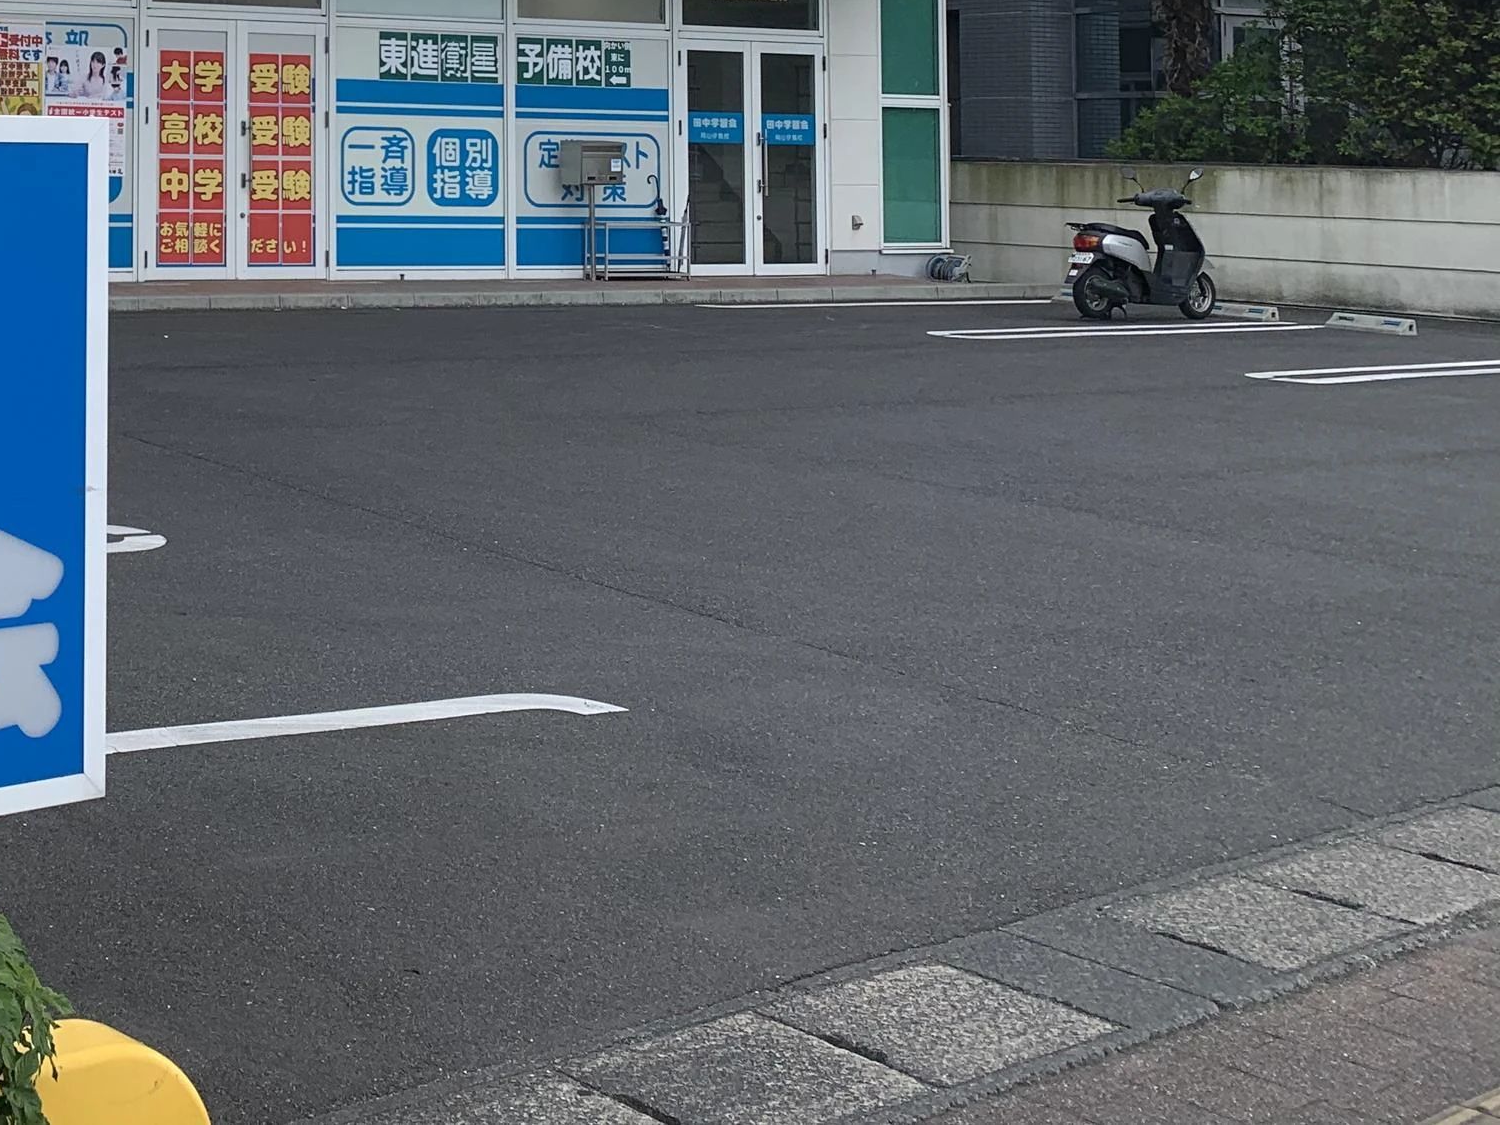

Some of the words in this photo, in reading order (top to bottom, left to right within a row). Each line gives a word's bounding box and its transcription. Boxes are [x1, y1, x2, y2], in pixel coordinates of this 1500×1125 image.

[379, 37, 499, 79] 東進衛星
[517, 42, 602, 81] 予備校
[605, 65, 632, 73] 100m
[161, 59, 224, 93] 大学
[250, 63, 311, 95] 受験
[161, 112, 224, 145] 高校
[251, 115, 311, 148] 受験
[693, 117, 737, 128] 田中学習会
[766, 119, 809, 130] 田中学習会
[347, 135, 408, 164] 一斉
[432, 136, 493, 168] 個別
[160, 167, 224, 201] 中学
[251, 169, 311, 201] 受験
[347, 165, 409, 196] 指導
[432, 168, 493, 199] 指導
[160, 221, 222, 237] お気軽に
[160, 238, 221, 254] ご相談く
